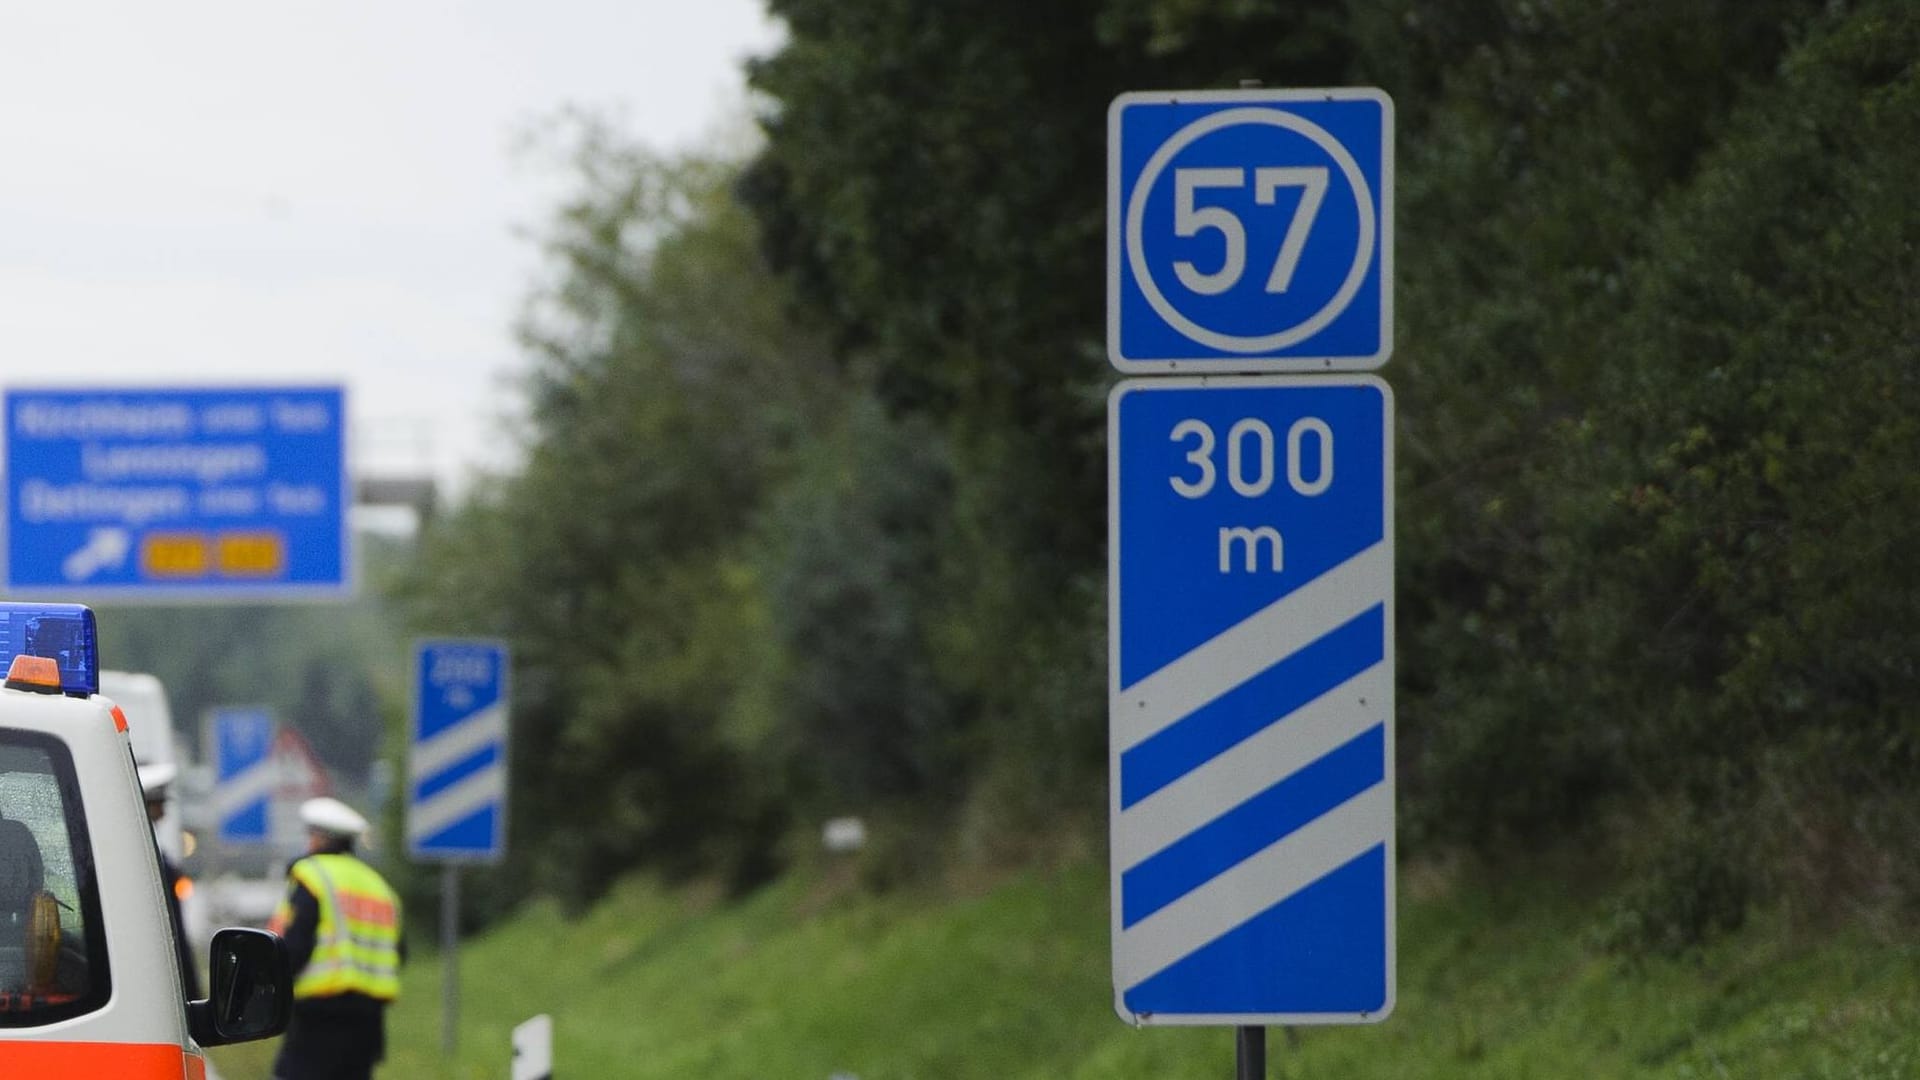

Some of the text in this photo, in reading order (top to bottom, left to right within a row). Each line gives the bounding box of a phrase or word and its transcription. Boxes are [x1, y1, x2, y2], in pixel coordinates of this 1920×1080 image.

[1173, 167, 1329, 295] 57
[1169, 417, 1333, 498] 300
[1219, 526, 1283, 572] m
